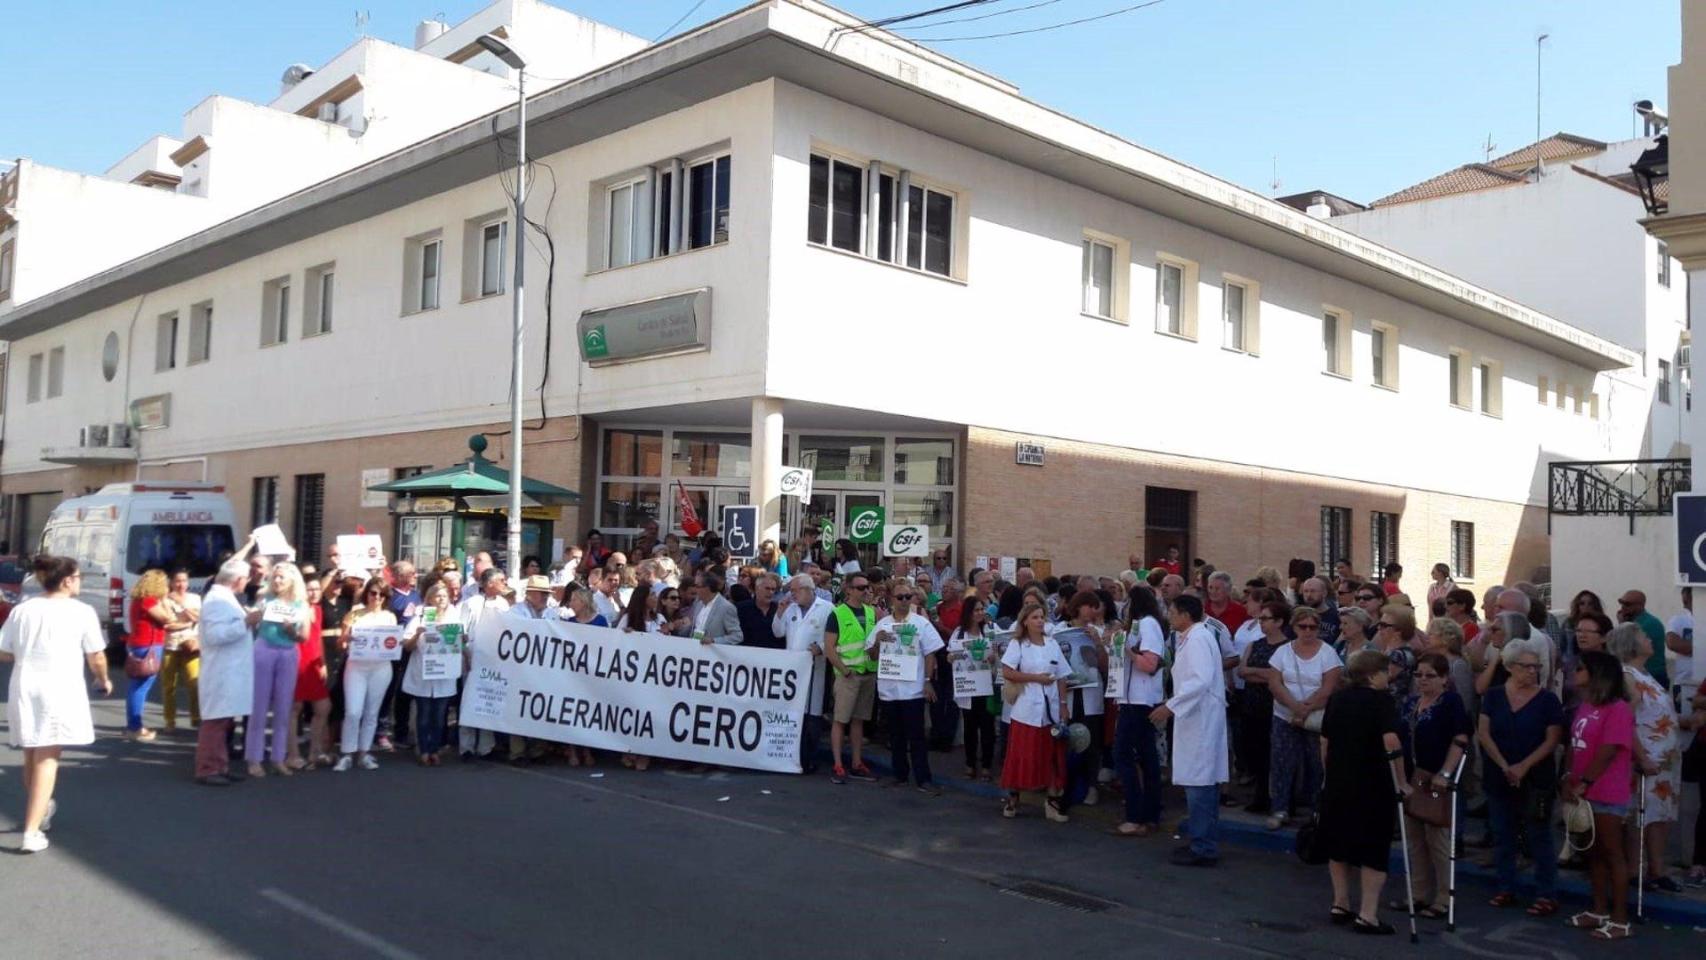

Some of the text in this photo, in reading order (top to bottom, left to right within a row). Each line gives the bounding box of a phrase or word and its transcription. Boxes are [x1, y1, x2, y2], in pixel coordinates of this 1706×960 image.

[152, 512, 214, 521] AMBULANCIA
[498, 630, 797, 701] CONTRA LAS AGRESIONES
[519, 690, 654, 739] TOLERANCIA
[669, 702, 762, 751] CERO
